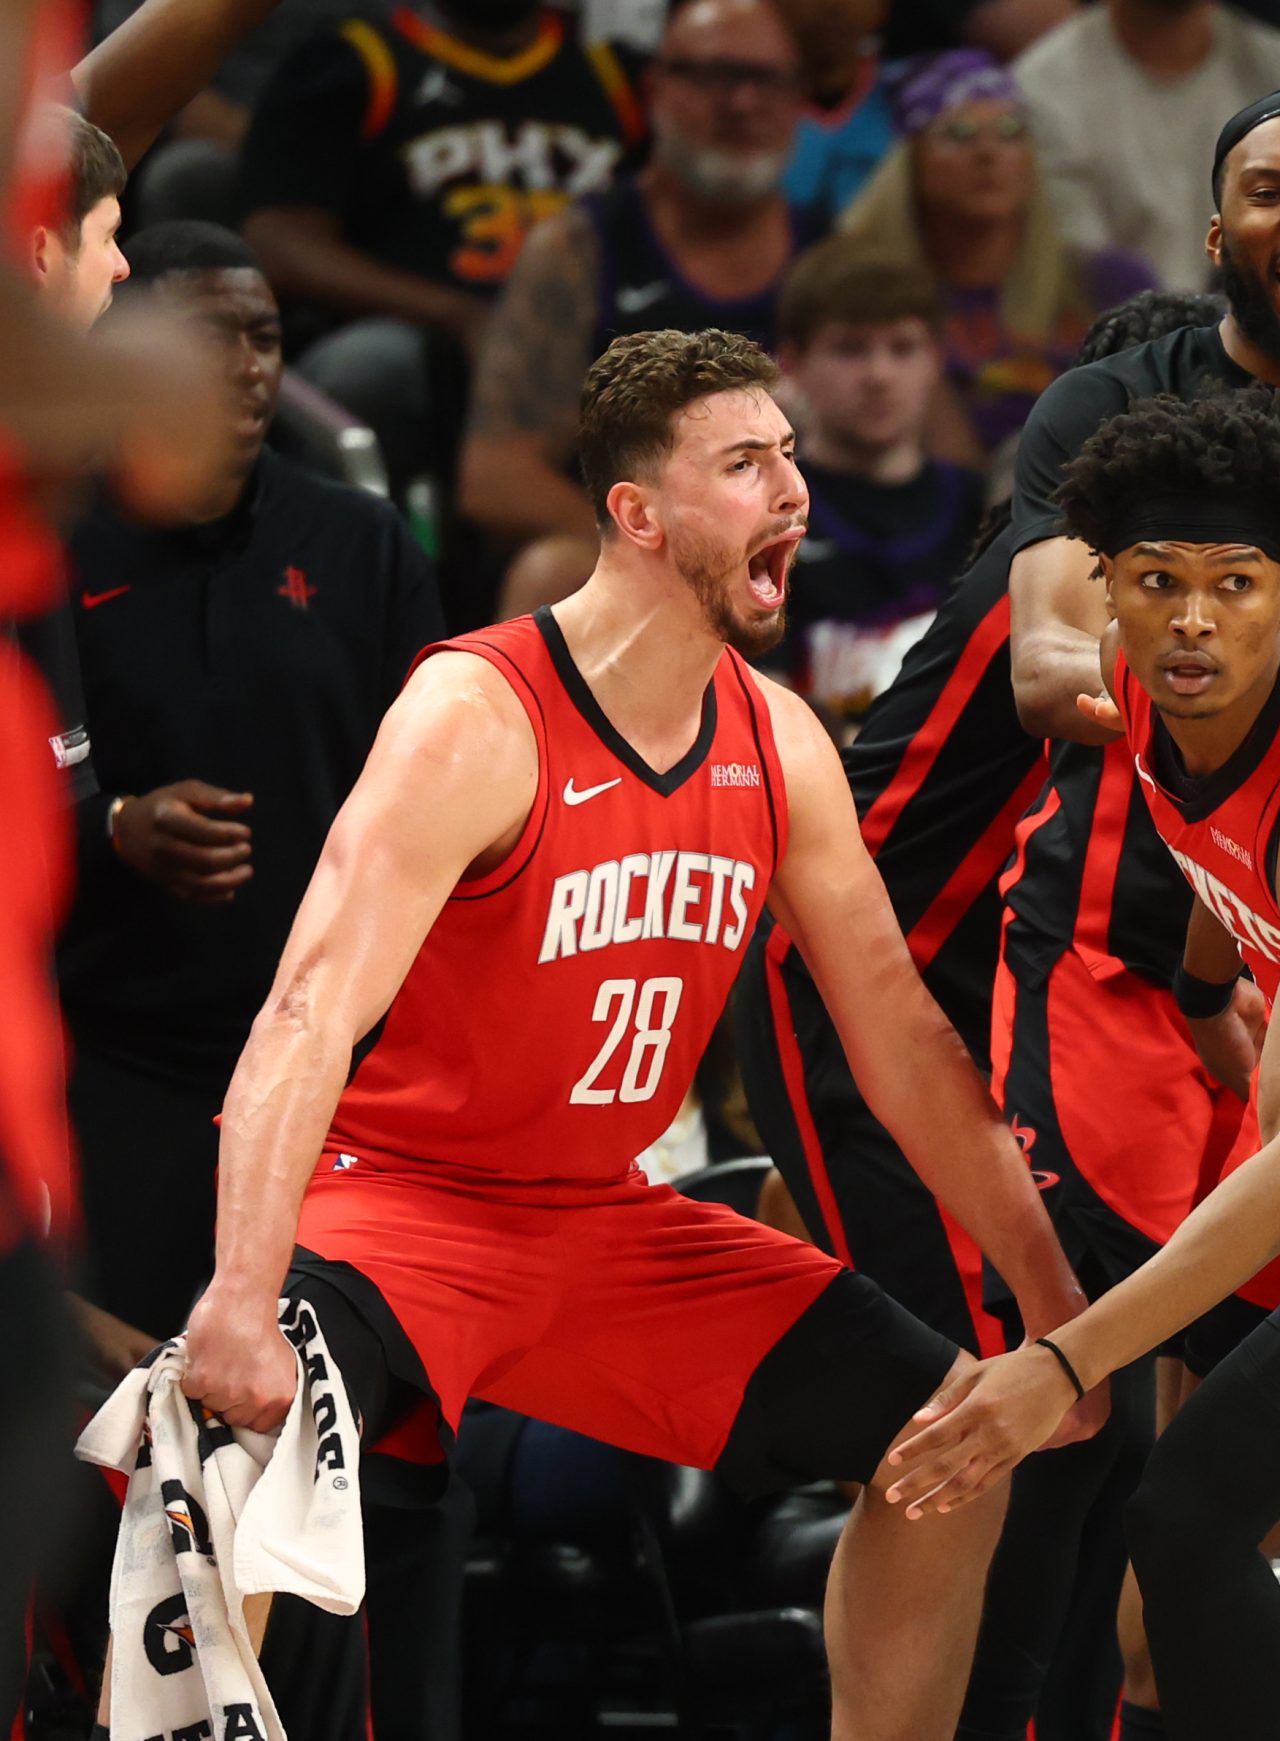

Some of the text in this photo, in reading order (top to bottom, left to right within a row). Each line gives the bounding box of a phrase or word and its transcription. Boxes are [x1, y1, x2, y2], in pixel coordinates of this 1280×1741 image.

[445, 185, 572, 283] 3
[711, 763, 759, 776] MEMORIAL
[711, 775, 759, 787] HERMANN
[538, 850, 756, 965] ROCKETS
[569, 977, 684, 1105] 28
